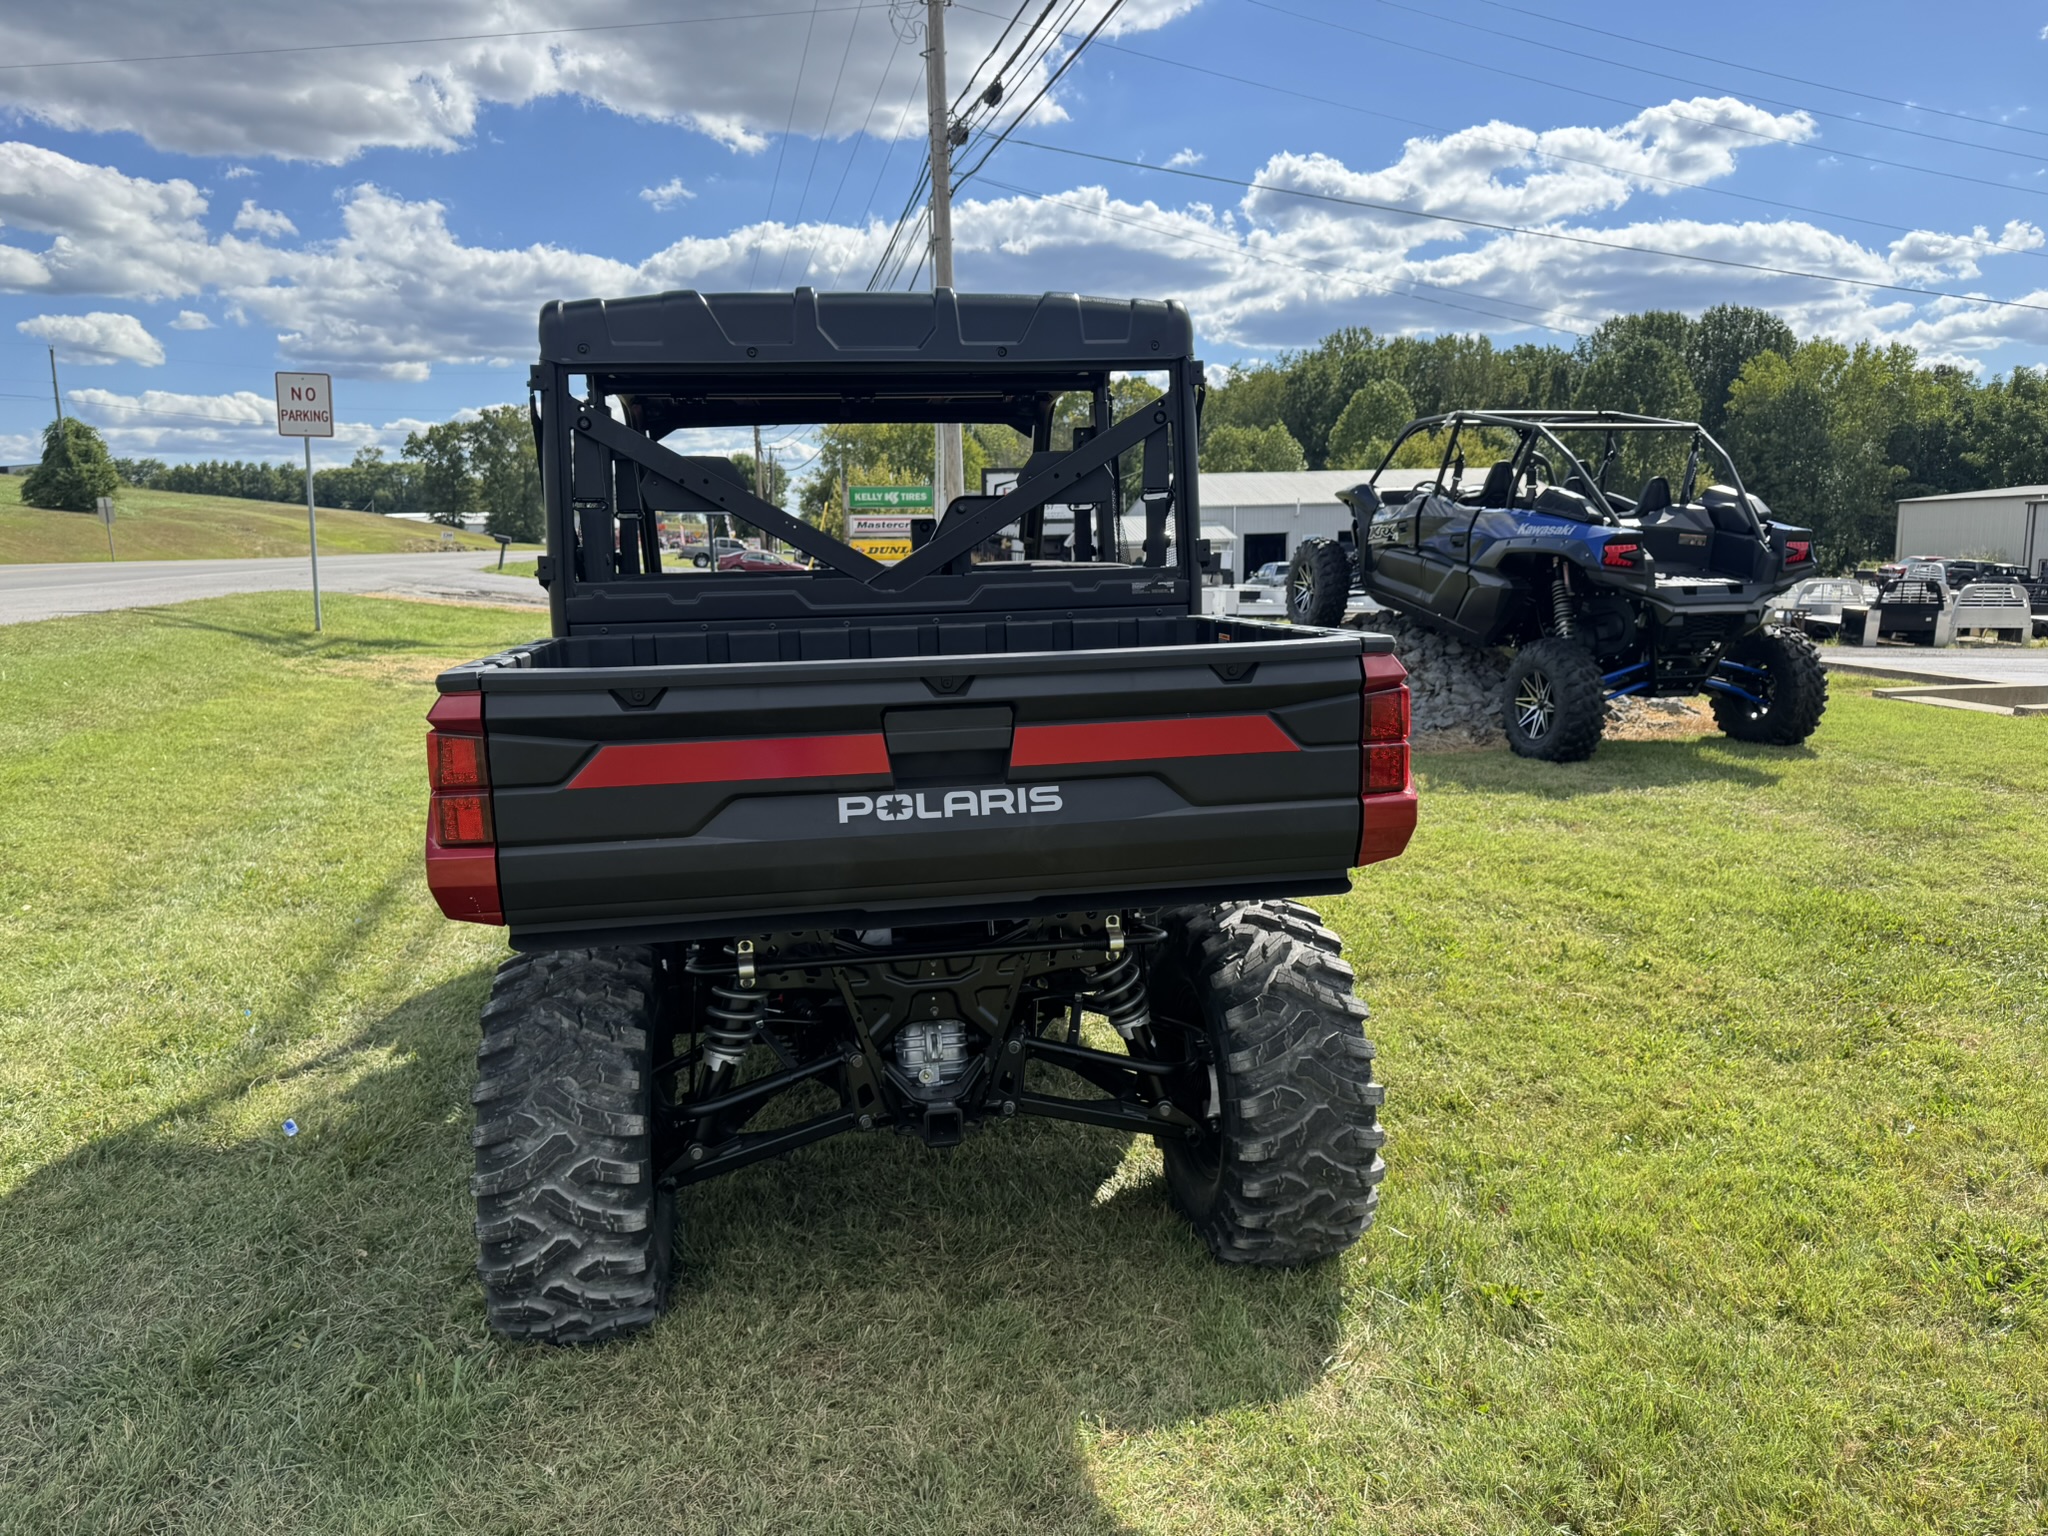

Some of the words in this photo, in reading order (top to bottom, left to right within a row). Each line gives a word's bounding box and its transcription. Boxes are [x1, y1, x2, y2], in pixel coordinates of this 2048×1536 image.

[290, 386, 316, 402] NO
[280, 409, 329, 423] PARKING
[854, 492, 883, 502] KELLY
[900, 492, 927, 501] TIRES
[856, 521, 911, 529] Mastercr
[1367, 523, 1398, 540] KRX
[1516, 522, 1578, 536] Kawasaki
[867, 546, 911, 555] DUNL
[837, 785, 1064, 824] POLARIS
